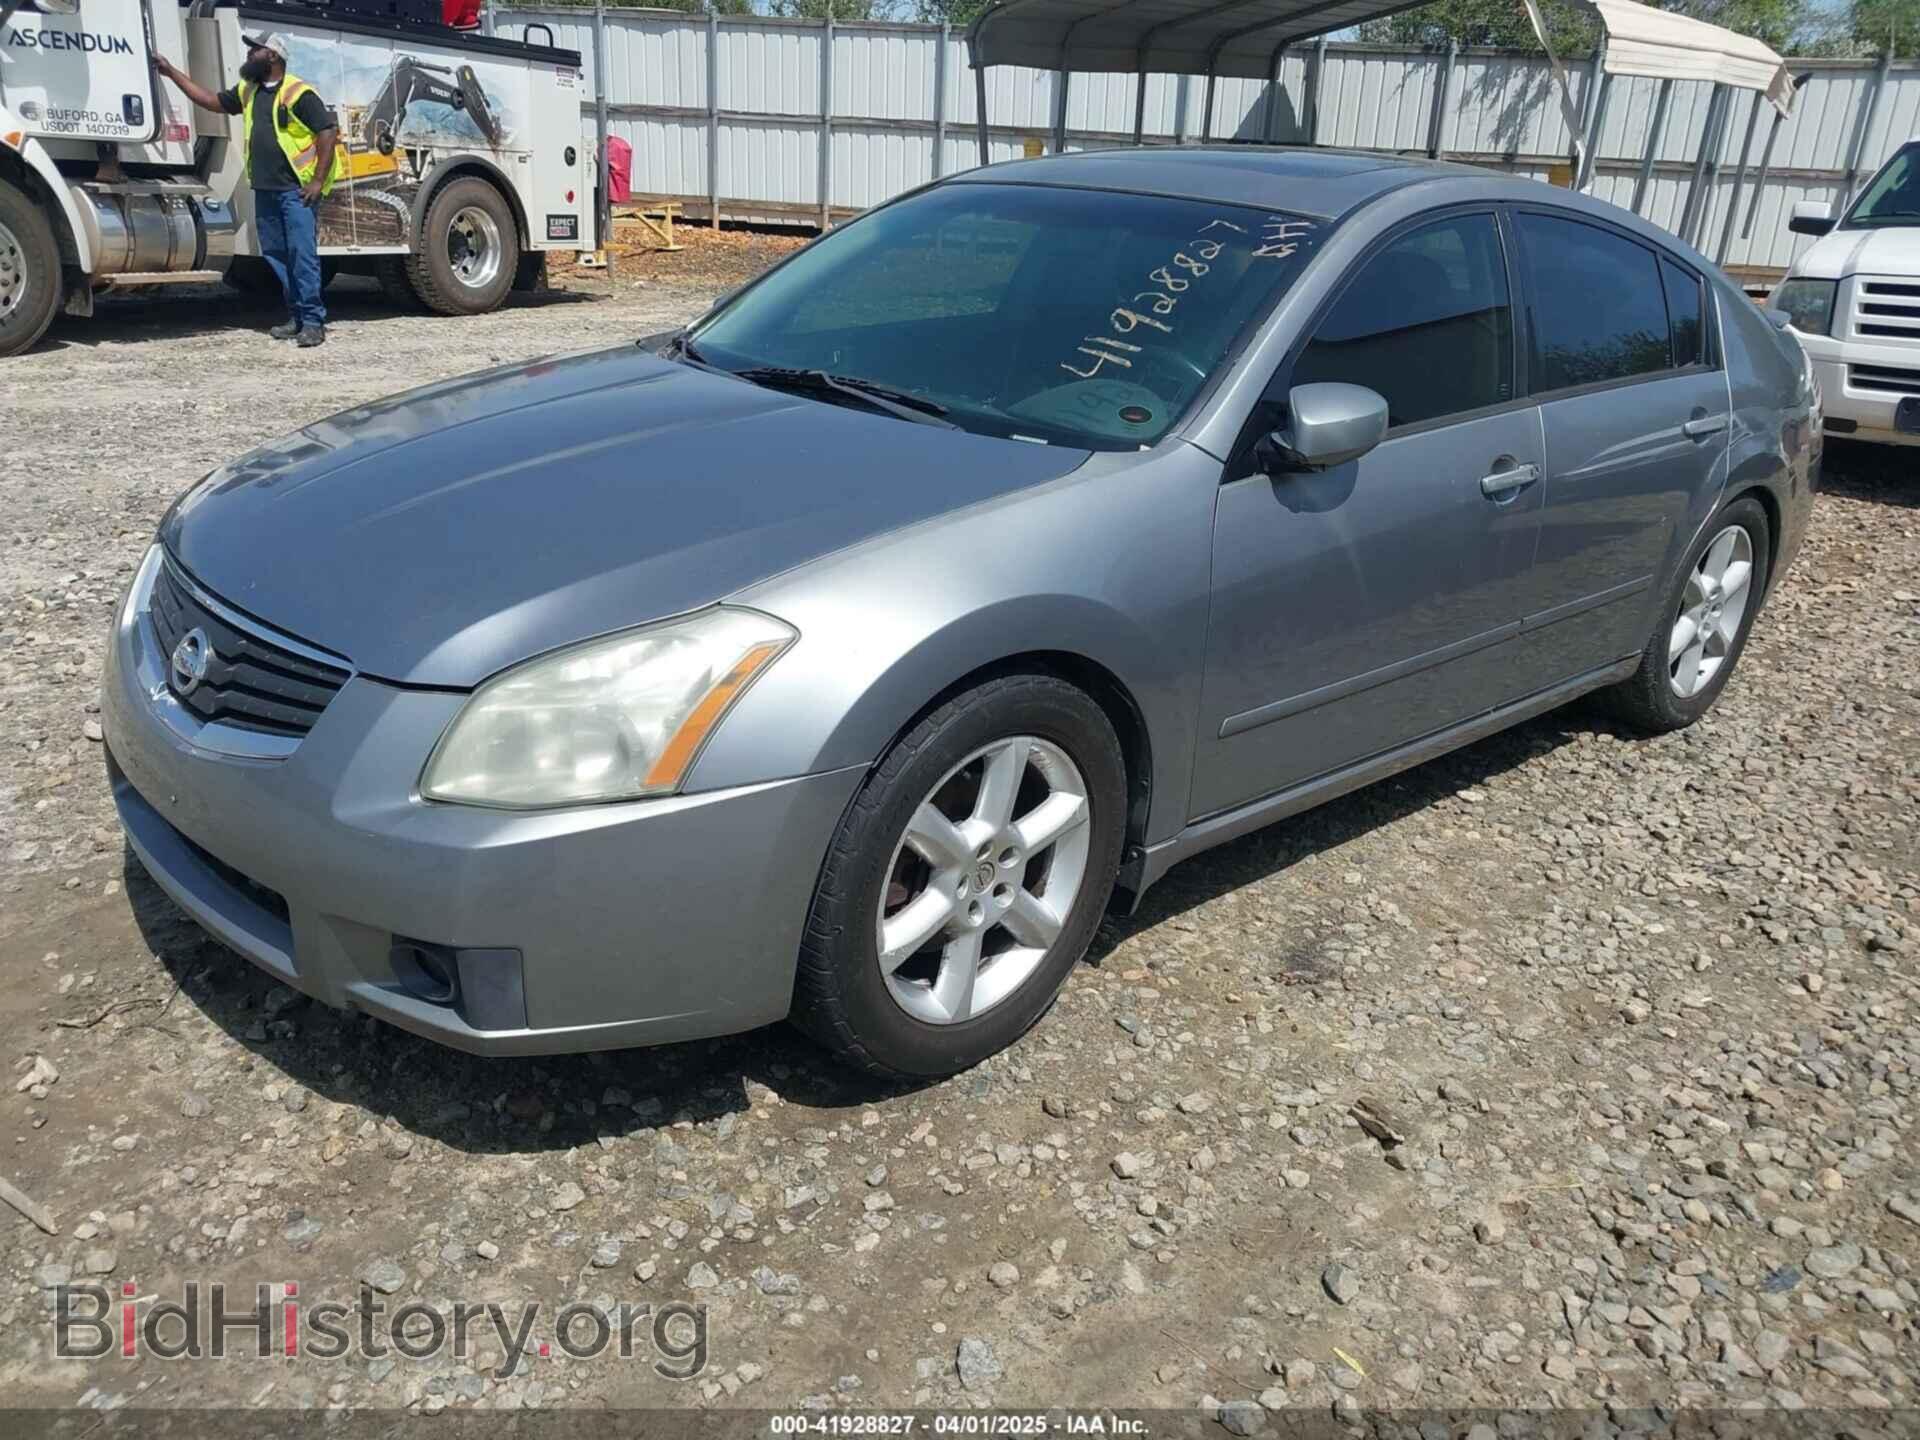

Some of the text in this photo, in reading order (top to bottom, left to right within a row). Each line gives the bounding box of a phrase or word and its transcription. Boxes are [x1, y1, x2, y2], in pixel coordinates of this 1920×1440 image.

[8, 29, 134, 55] ASCENDUM
[104, 112, 122, 123] GA
[41, 121, 130, 135] USDOT 1407319
[549, 218, 576, 226] EXPECT
[1060, 219, 1249, 378] 41928827
